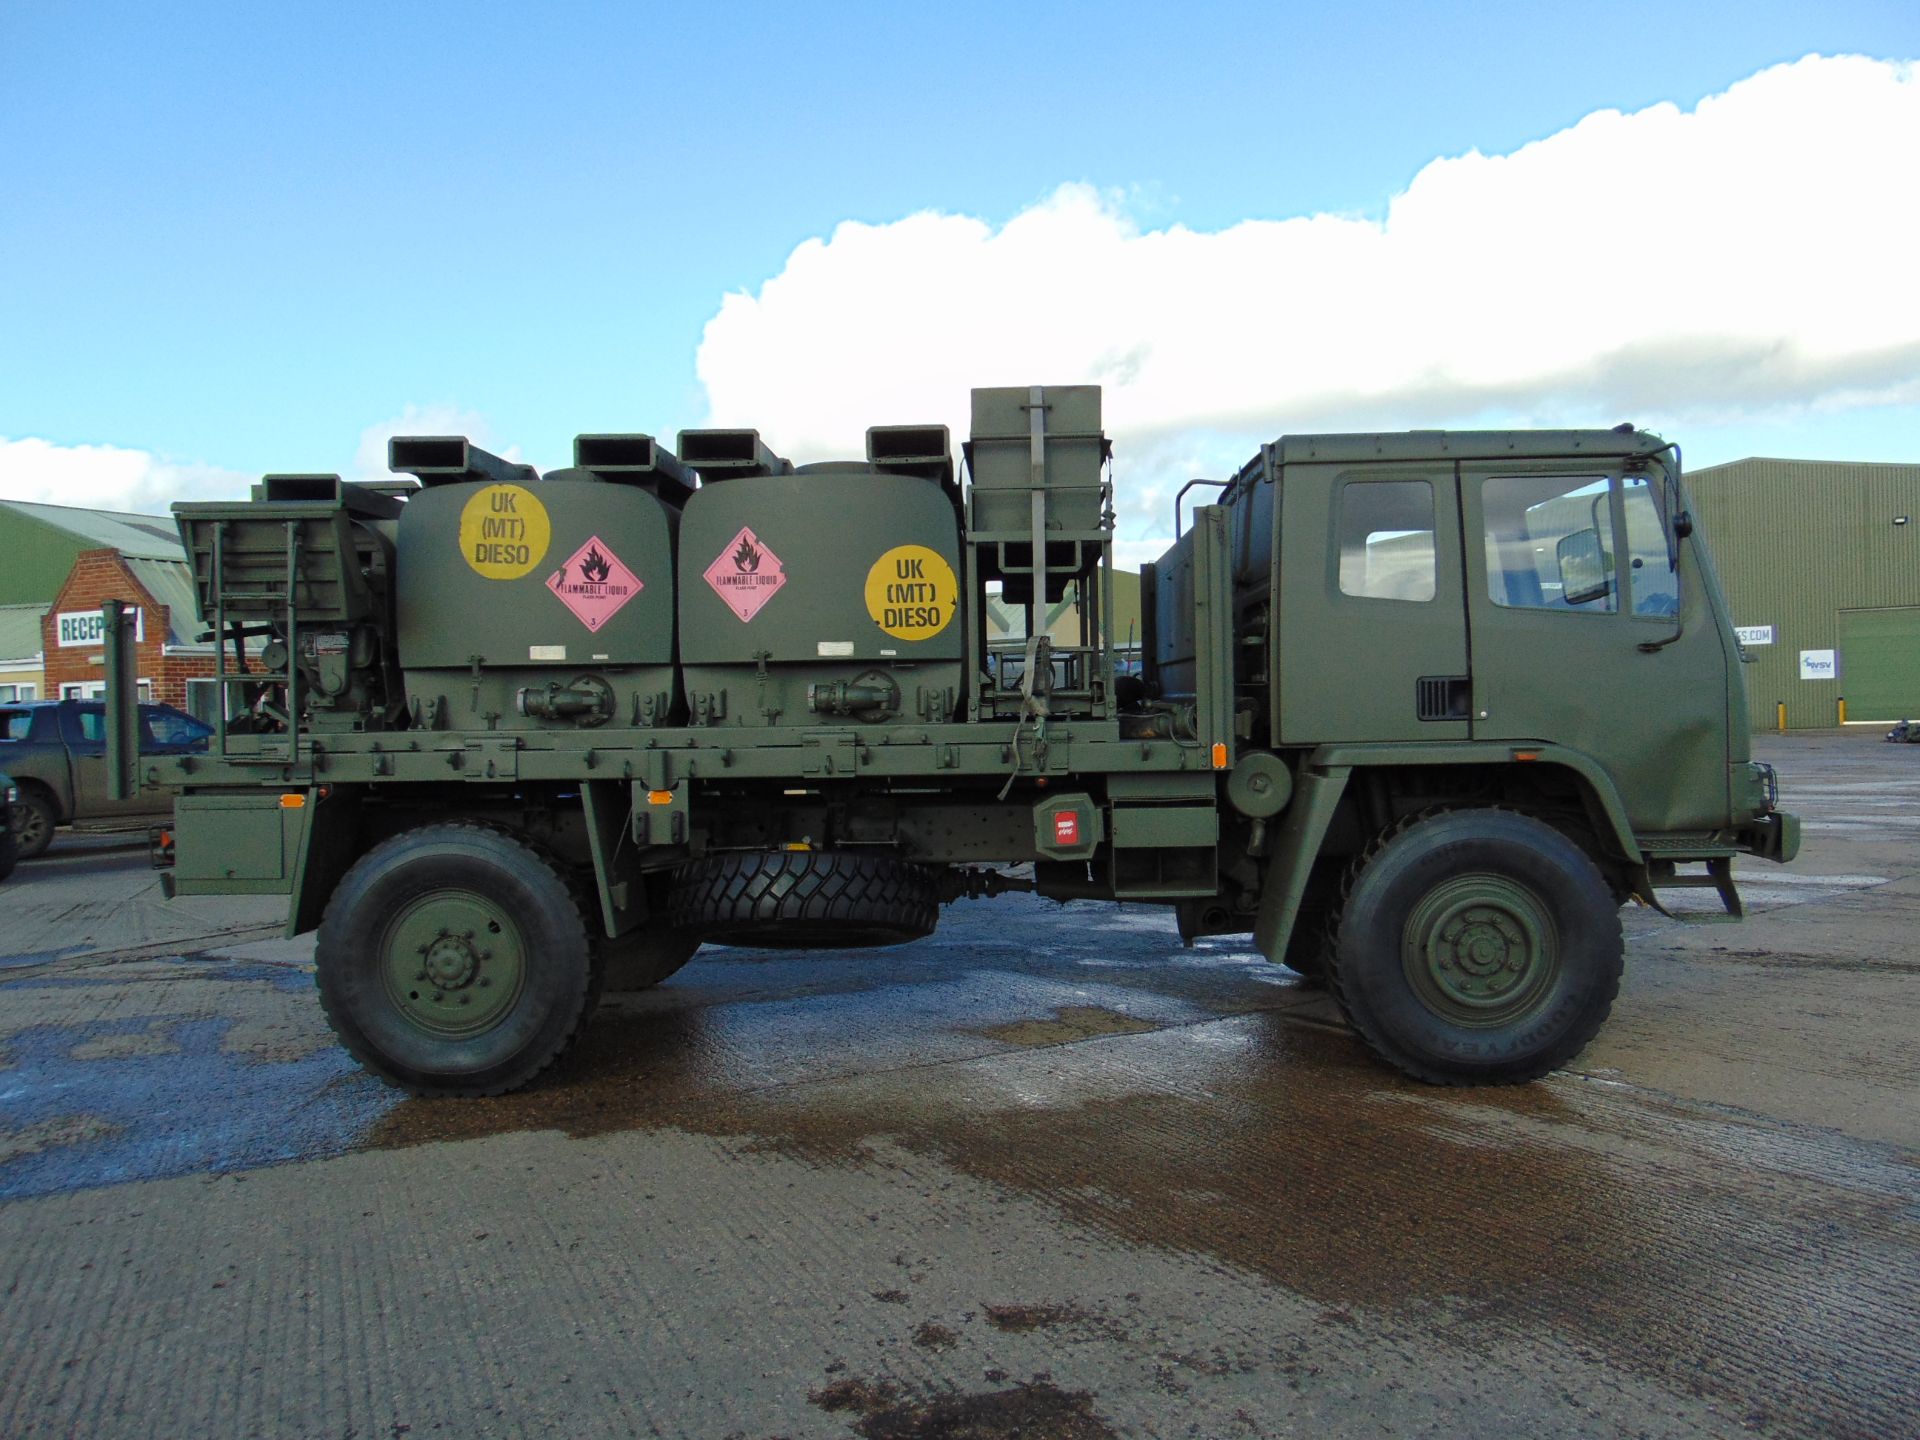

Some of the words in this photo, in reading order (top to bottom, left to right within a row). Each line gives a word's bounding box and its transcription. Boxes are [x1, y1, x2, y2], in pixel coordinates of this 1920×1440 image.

[491, 492, 517, 513] UK
[481, 516, 525, 541] (MT)
[475, 543, 530, 565] DIESO
[896, 559, 925, 579] UK
[560, 583, 602, 595] FLAMMABLE
[605, 585, 628, 596] LIQUID
[716, 575, 753, 586] FLAMMABLE
[756, 575, 778, 586] LIQUID
[886, 583, 936, 604] (MT)
[884, 607, 941, 628] DIESO
[61, 616, 104, 641] RECEP
[1736, 629, 1770, 641] S.COM
